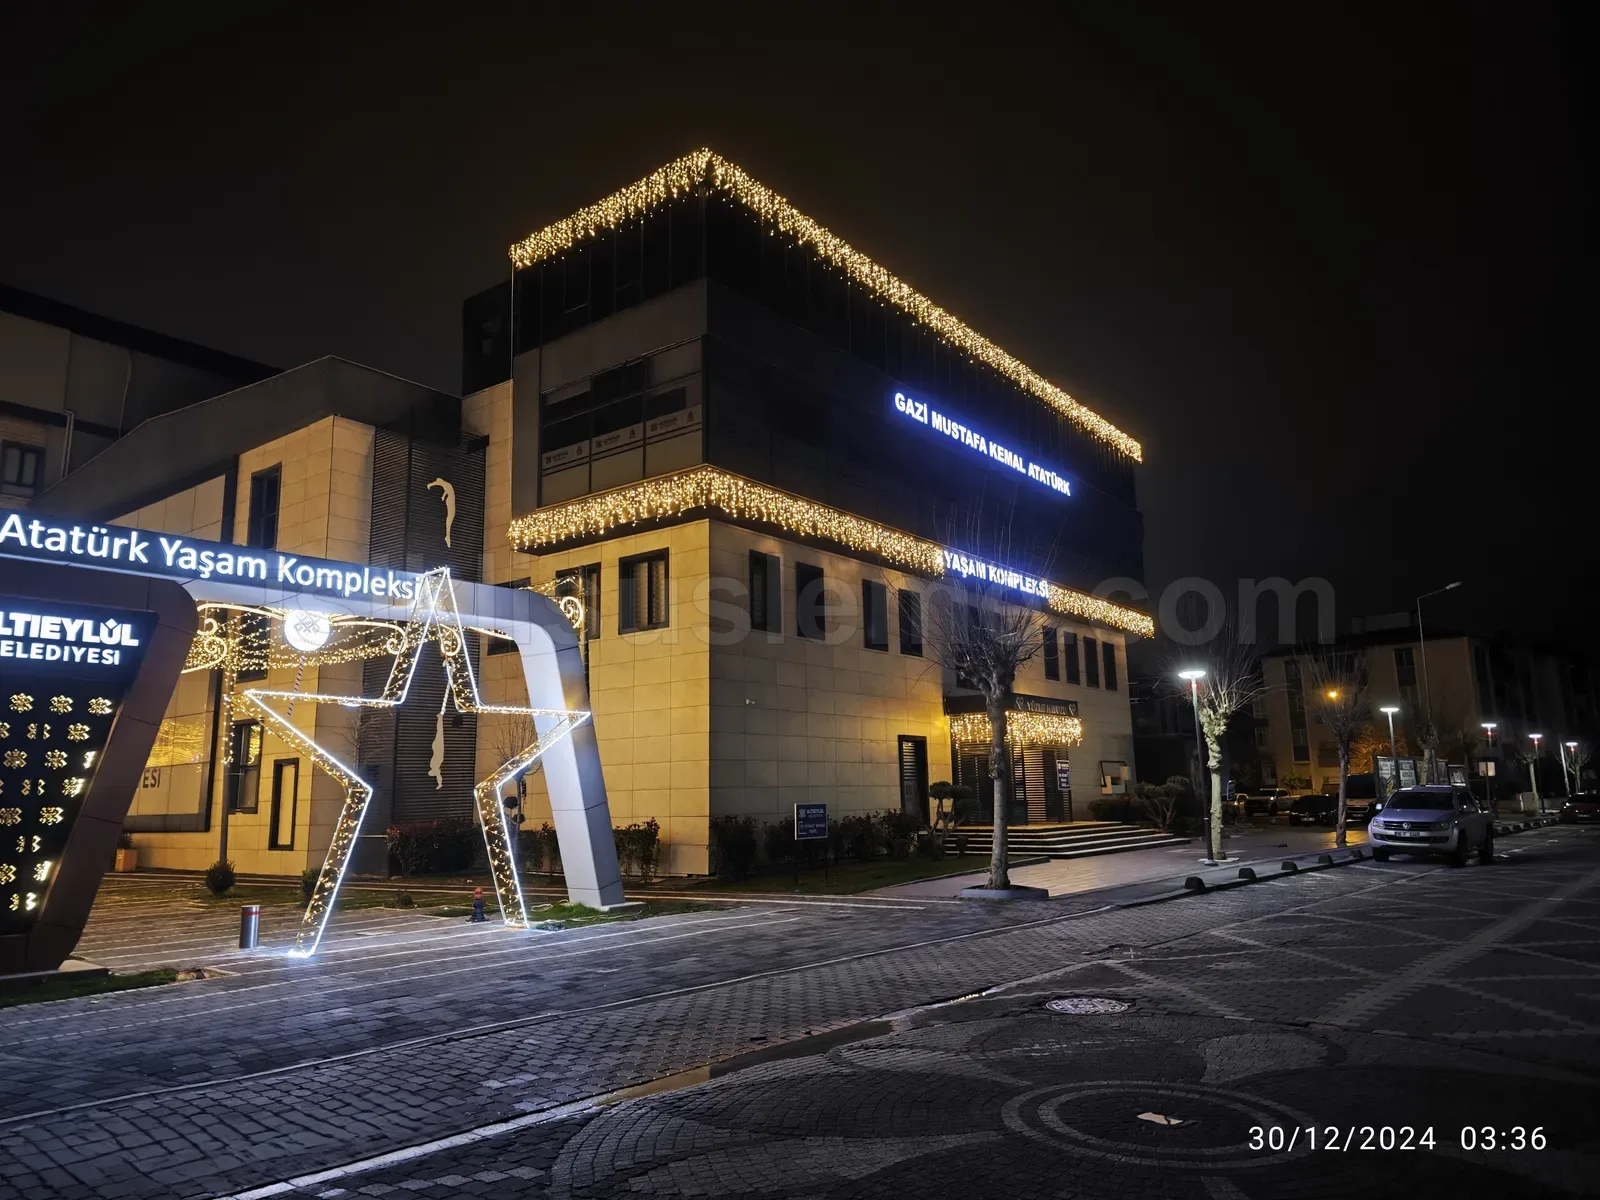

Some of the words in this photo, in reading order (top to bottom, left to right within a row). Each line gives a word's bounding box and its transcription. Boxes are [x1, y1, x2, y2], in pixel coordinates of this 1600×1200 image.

[894, 392, 928, 424] GAZİ
[931, 410, 988, 455] MUSTAFA
[989, 440, 1026, 474] KEMAL
[1028, 462, 1071, 496] ATATÜRK
[0, 513, 149, 564] Atatürk
[159, 537, 267, 578] Yaşam
[277, 555, 421, 600] Kompleksi
[944, 551, 987, 578] YAŞAM
